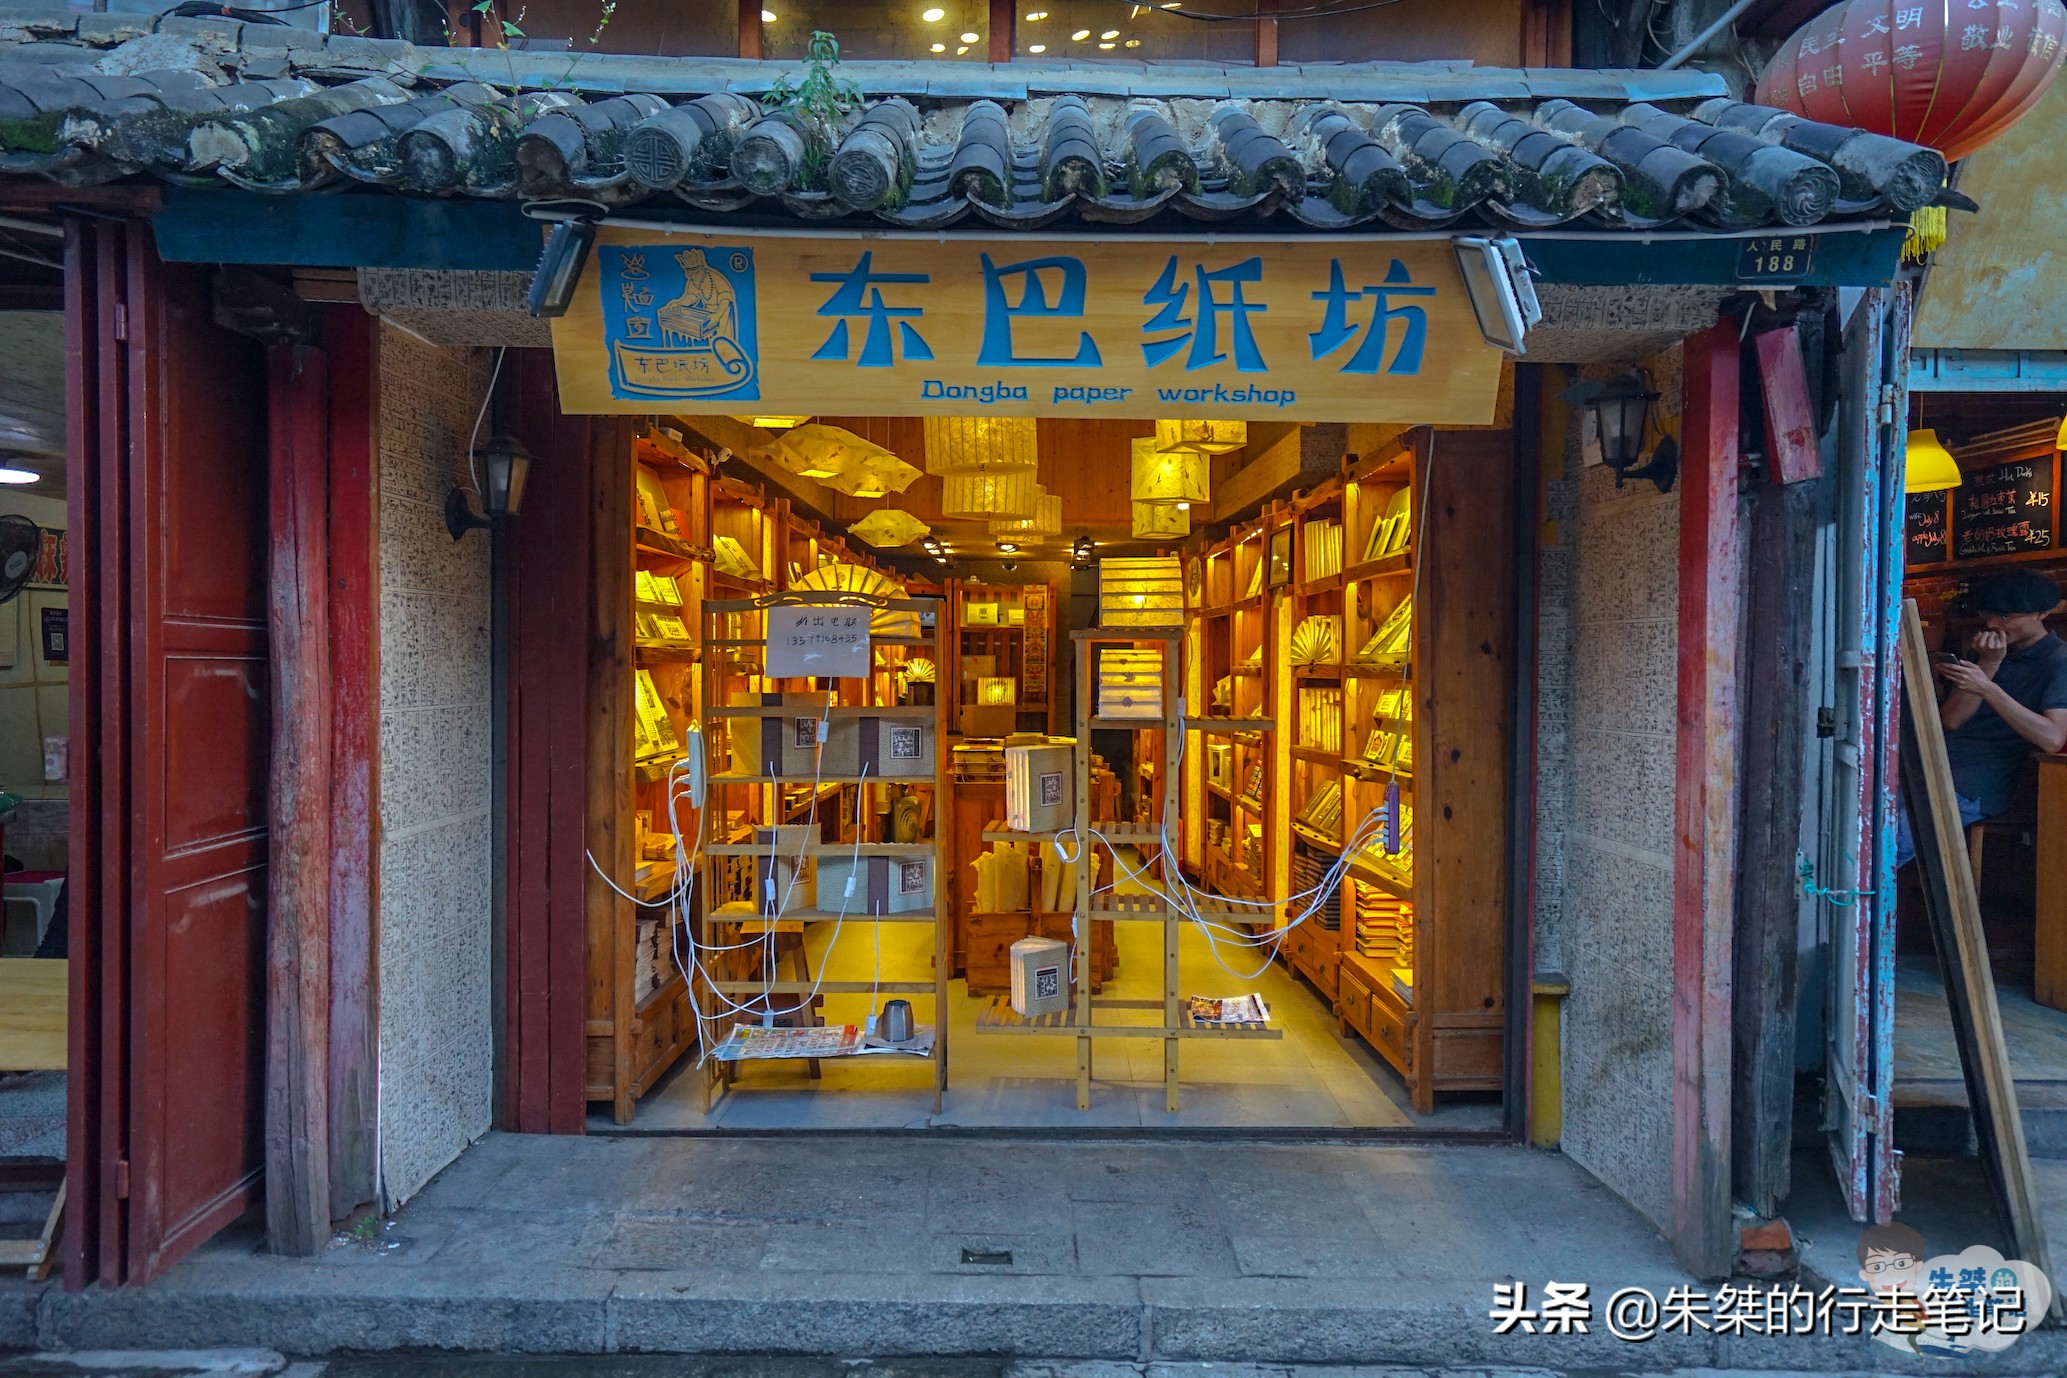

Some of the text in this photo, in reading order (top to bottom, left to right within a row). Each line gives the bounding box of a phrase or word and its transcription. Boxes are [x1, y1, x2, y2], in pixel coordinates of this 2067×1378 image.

[1860, 6, 1923, 39] 文明
[1797, 64, 1844, 98] 自由
[1860, 43, 1923, 77] 平等
[1960, 24, 2013, 51] 敬业
[1746, 238, 1806, 252] 人民路
[1754, 255, 1795, 271] 188
[809, 250, 1437, 375] 东巴纸坊
[634, 356, 711, 375] 东巴纸坊
[921, 379, 1296, 408] Dongba paper workshop
[2024, 490, 2051, 507] ¥15
[2023, 528, 2051, 548] ¥25
[795, 615, 857, 627] 外出电联
